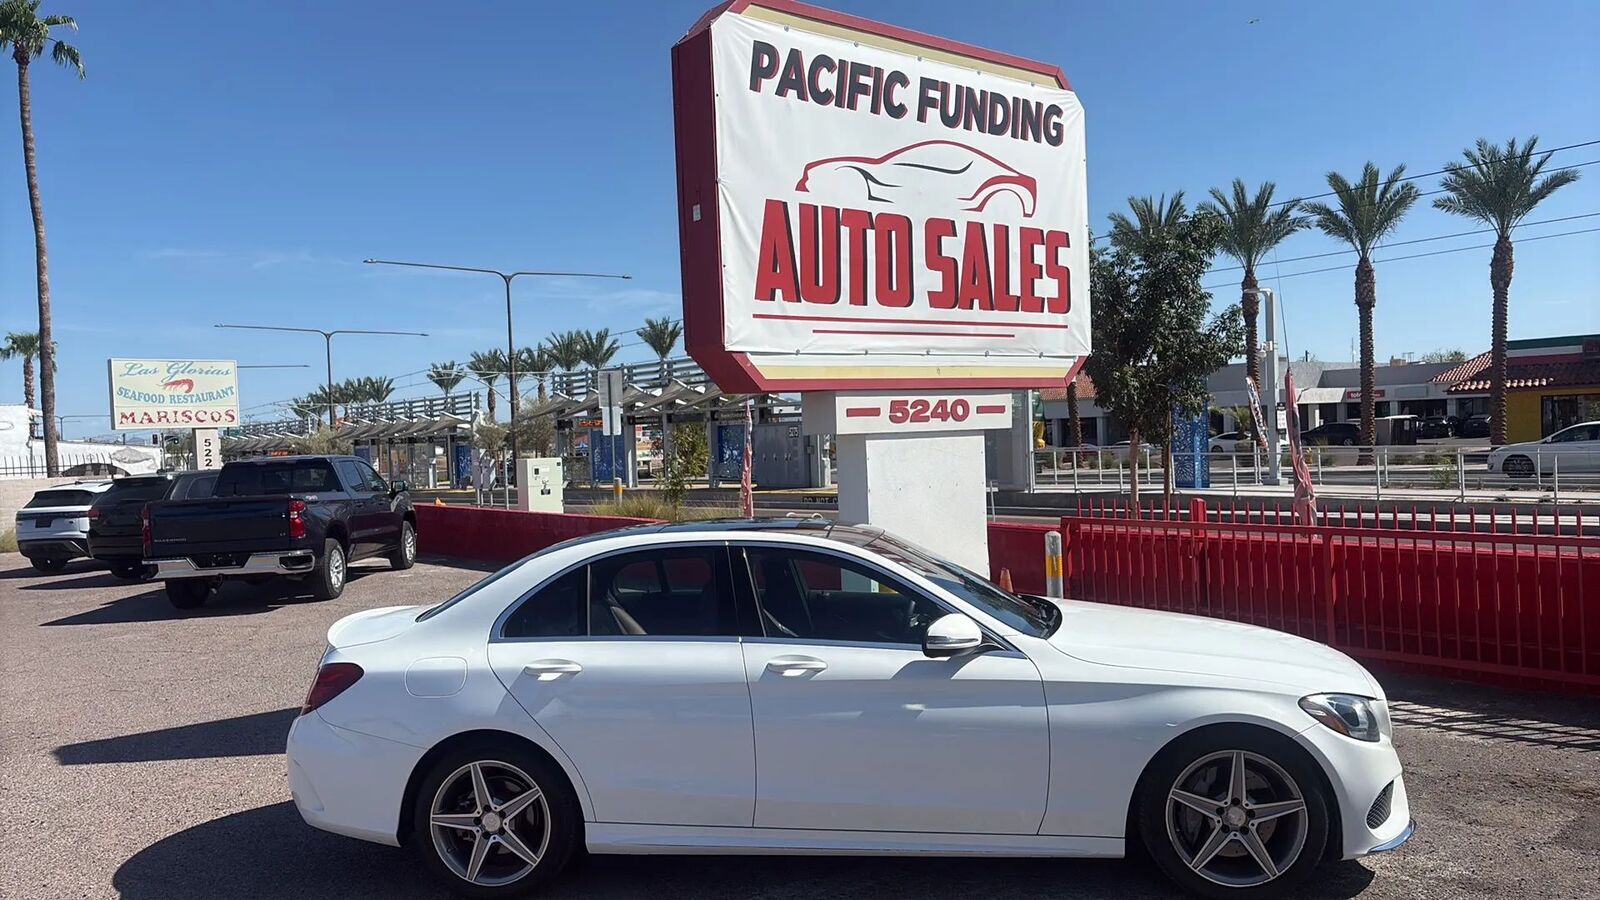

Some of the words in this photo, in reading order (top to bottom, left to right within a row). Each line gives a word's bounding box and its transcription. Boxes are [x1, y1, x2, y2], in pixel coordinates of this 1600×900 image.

[749, 40, 910, 120] PACIFIC
[916, 76, 1064, 147] FUNDING
[754, 198, 914, 308] AUTO
[924, 217, 1071, 314] SALES
[120, 362, 159, 377] Las
[160, 361, 231, 383] Glorias
[117, 386, 165, 404] SEAFOOD
[170, 386, 234, 404] RESTAURANT
[120, 409, 235, 424] MARISCOS
[888, 399, 970, 424] 5240
[204, 438, 213, 468] 522
